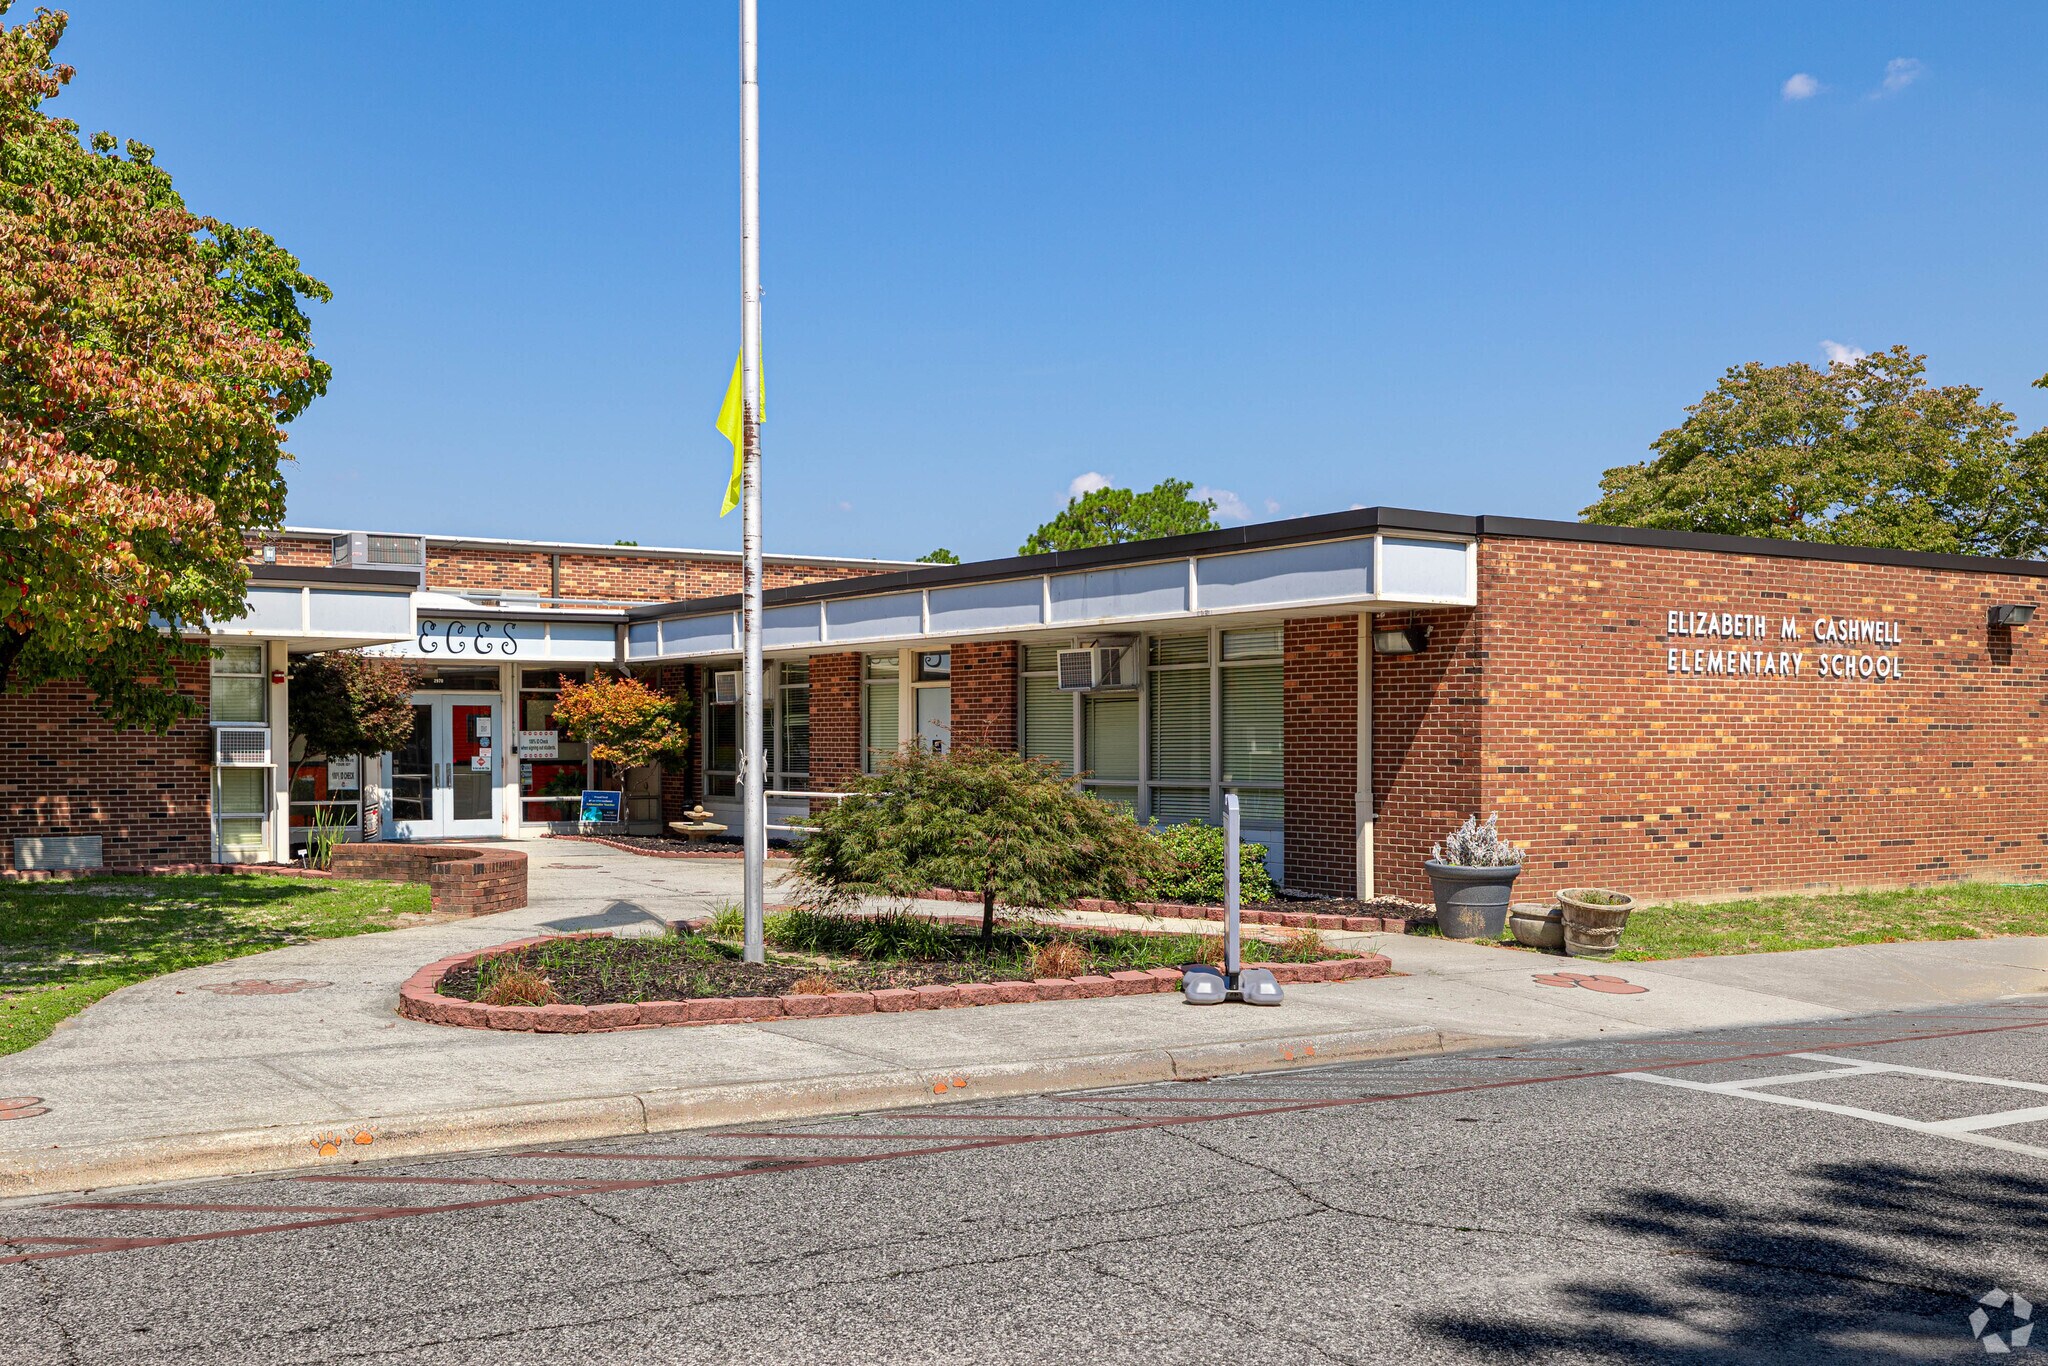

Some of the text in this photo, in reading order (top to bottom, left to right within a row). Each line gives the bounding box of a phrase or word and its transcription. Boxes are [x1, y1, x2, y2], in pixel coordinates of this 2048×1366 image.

[1667, 610, 1902, 643] ELIZABETH M. CASHWELL
[1667, 648, 1902, 678] ELEMENTARY SCHOOL
